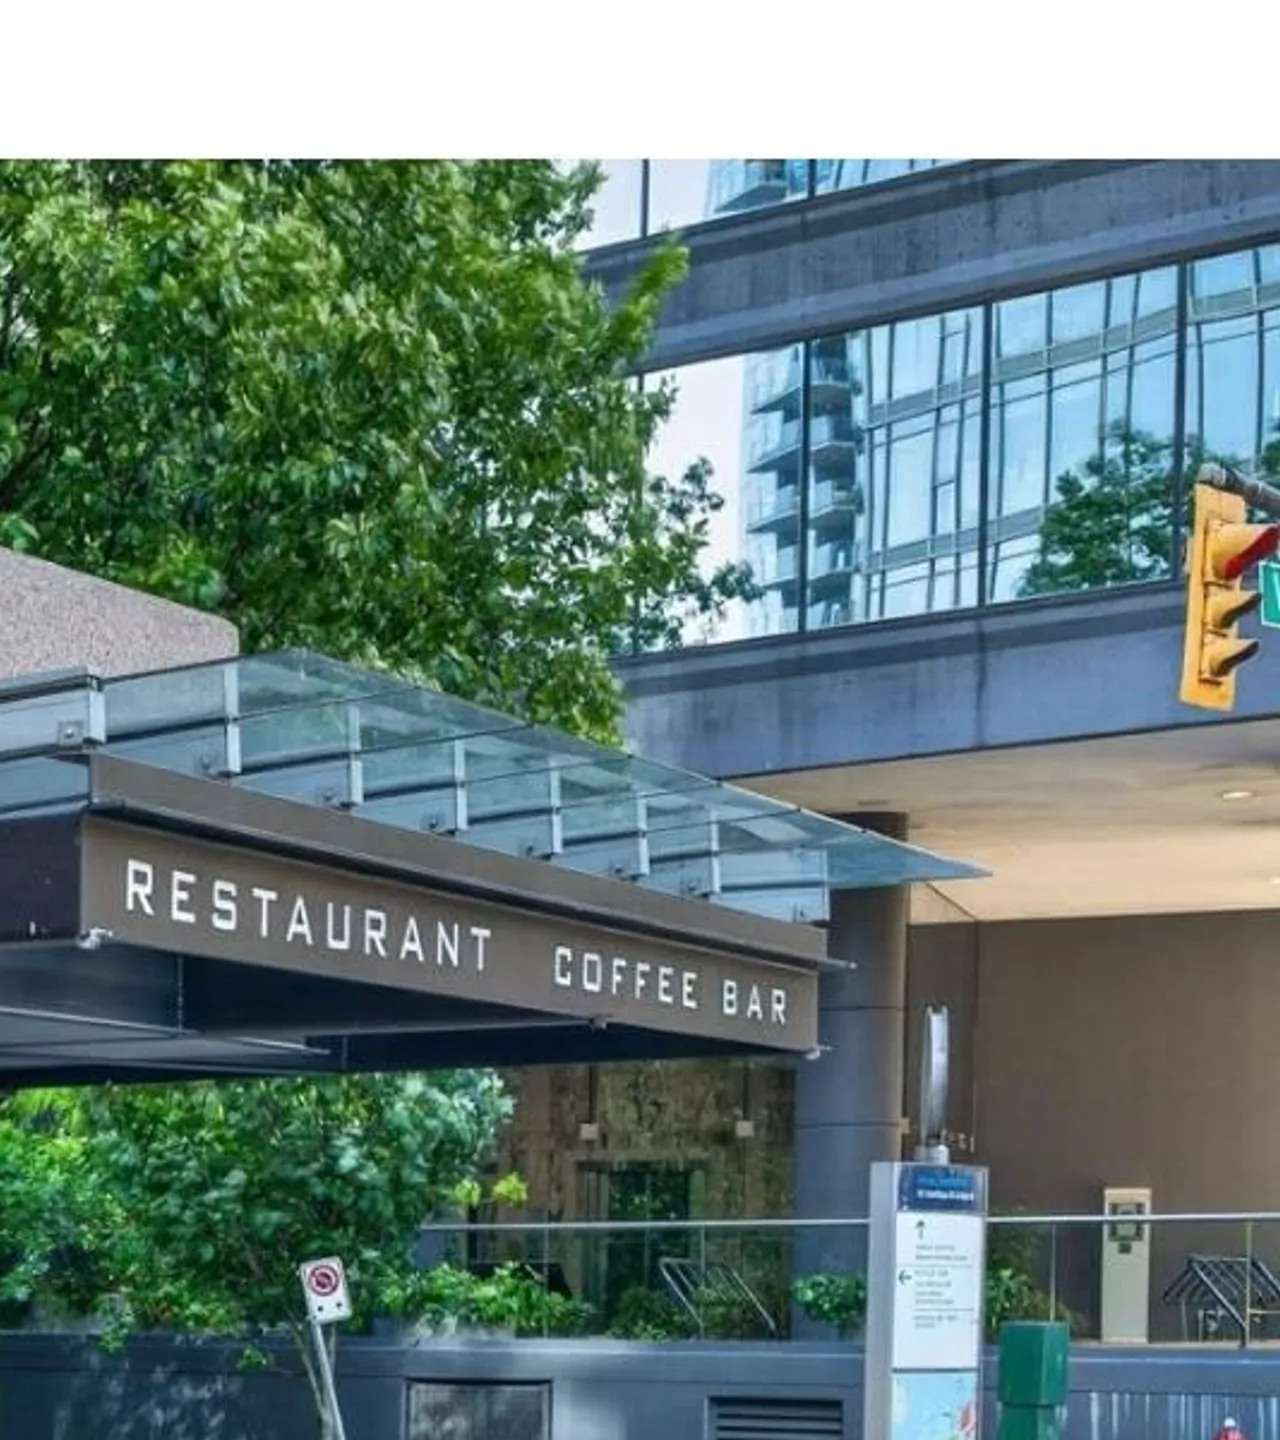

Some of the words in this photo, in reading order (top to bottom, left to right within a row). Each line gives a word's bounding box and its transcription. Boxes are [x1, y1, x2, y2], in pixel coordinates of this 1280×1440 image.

[126, 858, 492, 971] RESTAURANT
[554, 945, 699, 1010] COFFEE
[722, 978, 787, 1026] BAR
